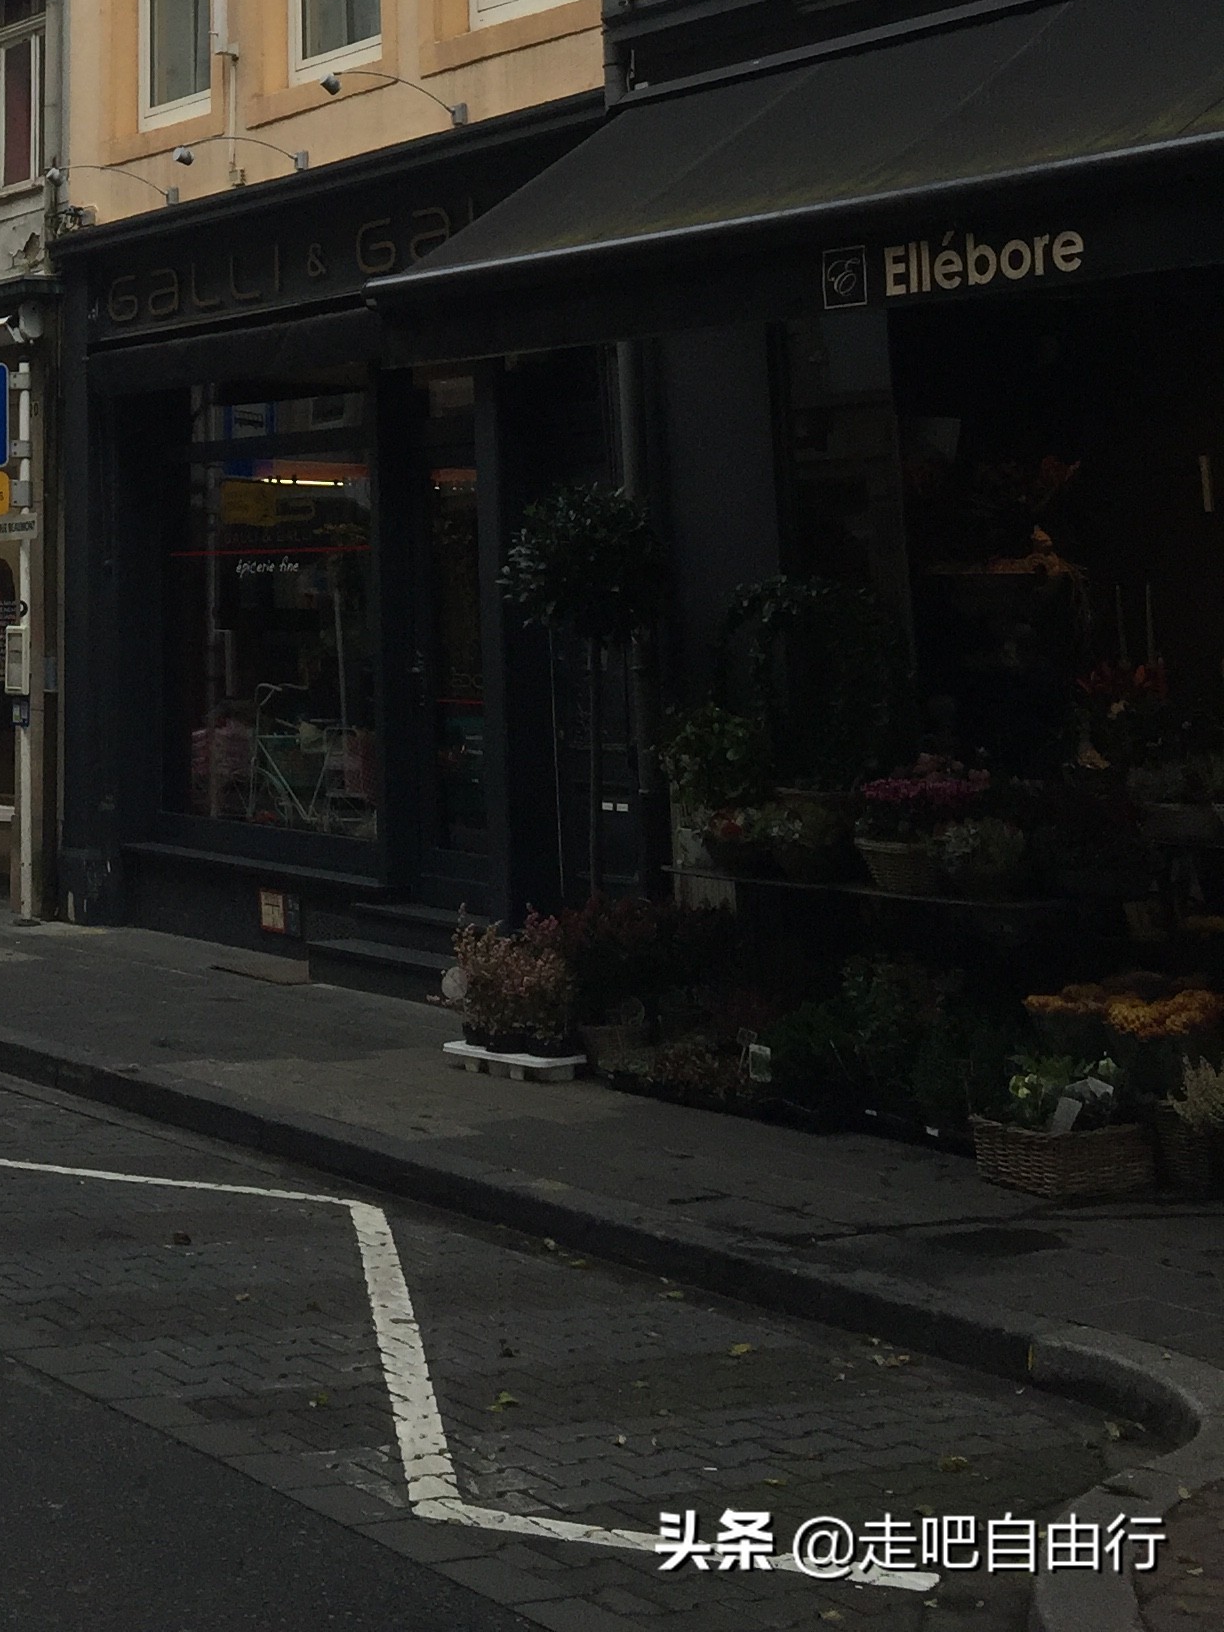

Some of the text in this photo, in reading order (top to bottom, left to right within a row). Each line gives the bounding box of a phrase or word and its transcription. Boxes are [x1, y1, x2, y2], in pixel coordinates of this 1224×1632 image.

[305, 242, 327, 277] &
[882, 229, 1085, 297] Ellébore
[279, 555, 300, 573] fine
